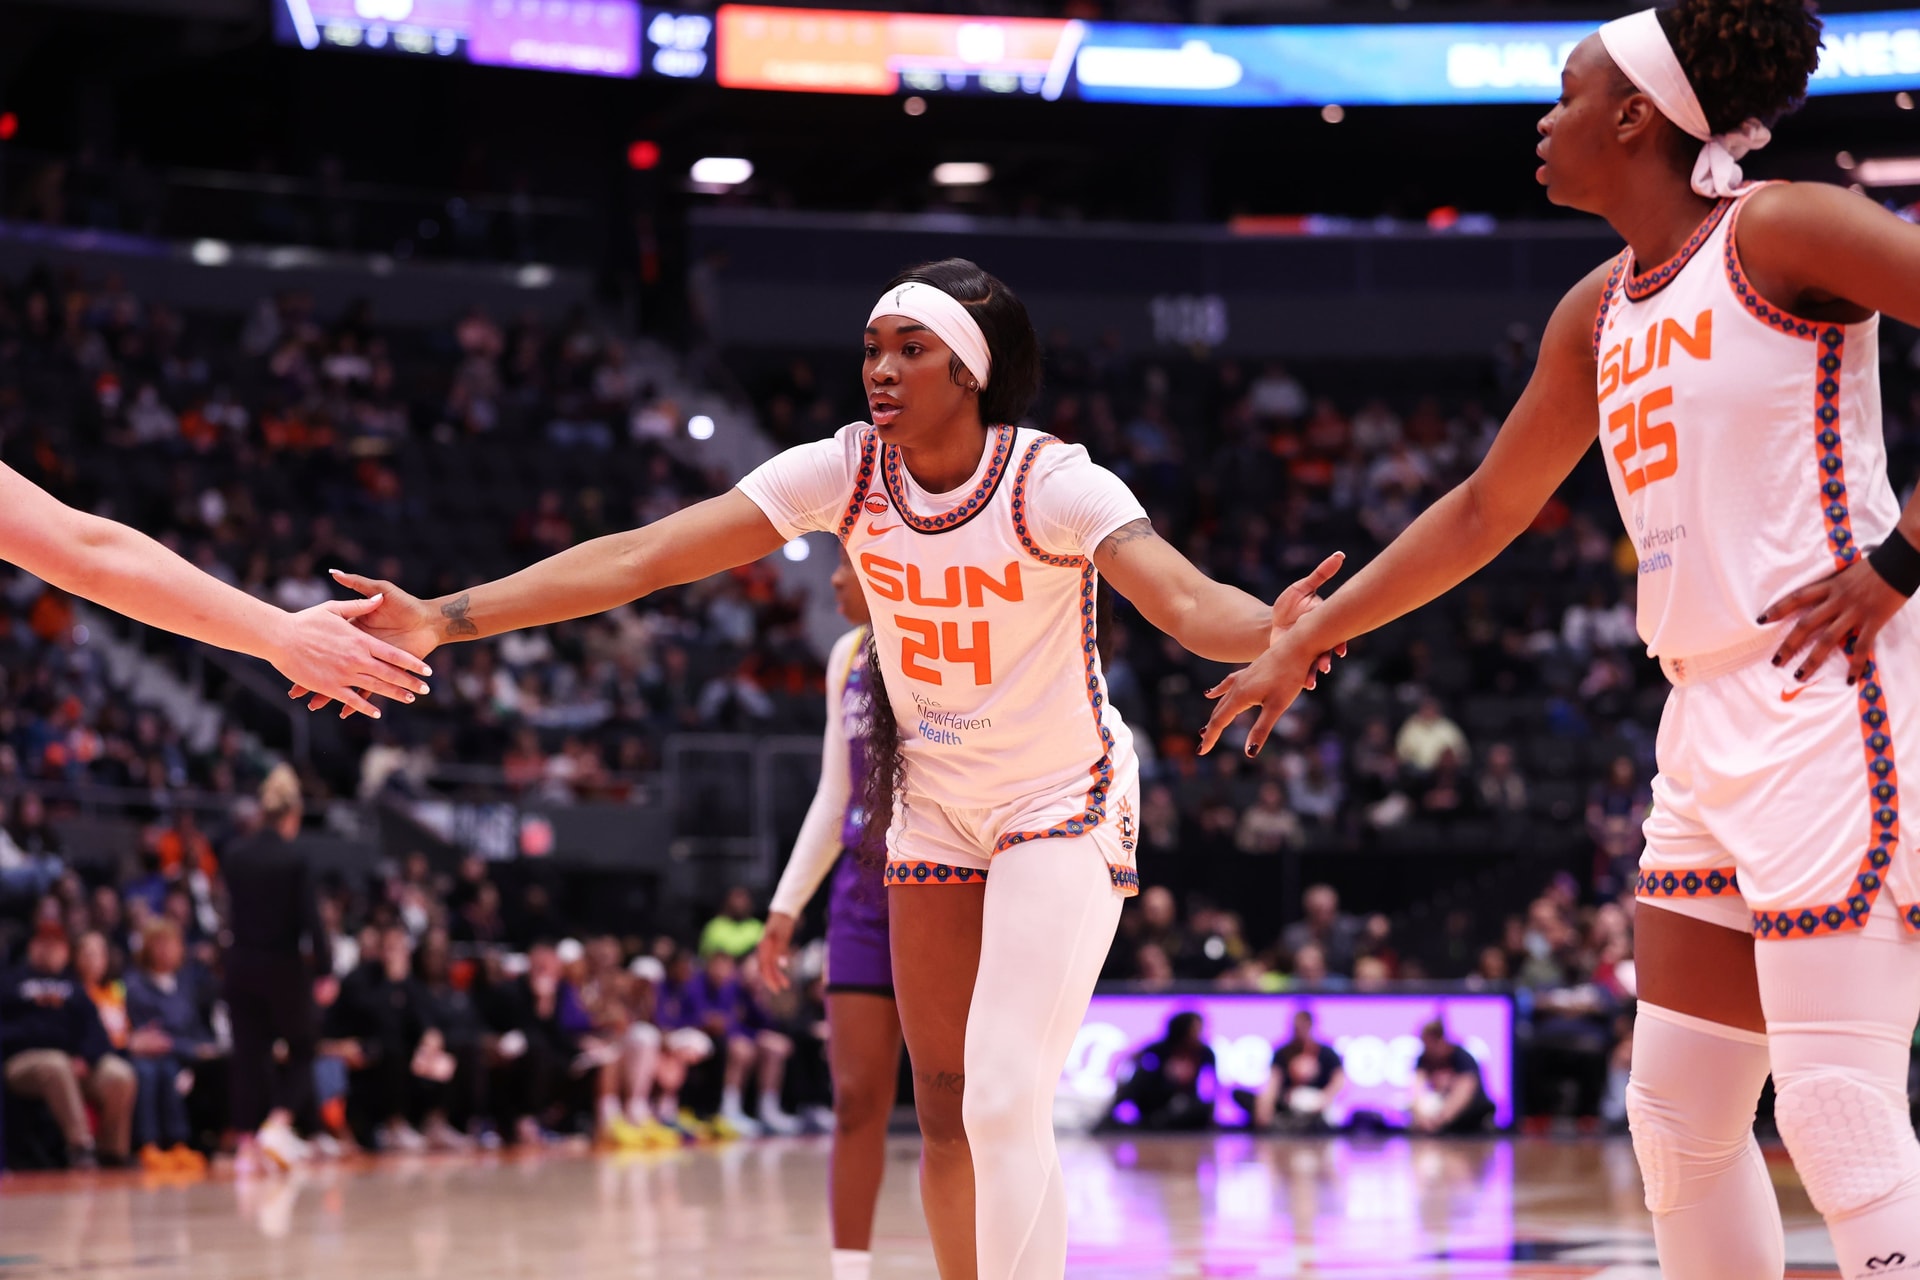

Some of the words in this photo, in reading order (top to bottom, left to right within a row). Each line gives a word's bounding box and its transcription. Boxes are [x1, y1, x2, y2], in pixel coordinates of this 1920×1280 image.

[1598, 309, 1712, 404] SUN
[1608, 385, 1678, 496] 25
[860, 552, 1024, 608] SUN
[894, 614, 992, 686] 24
[917, 704, 992, 730] NewHaven
[918, 720, 963, 746] Health
